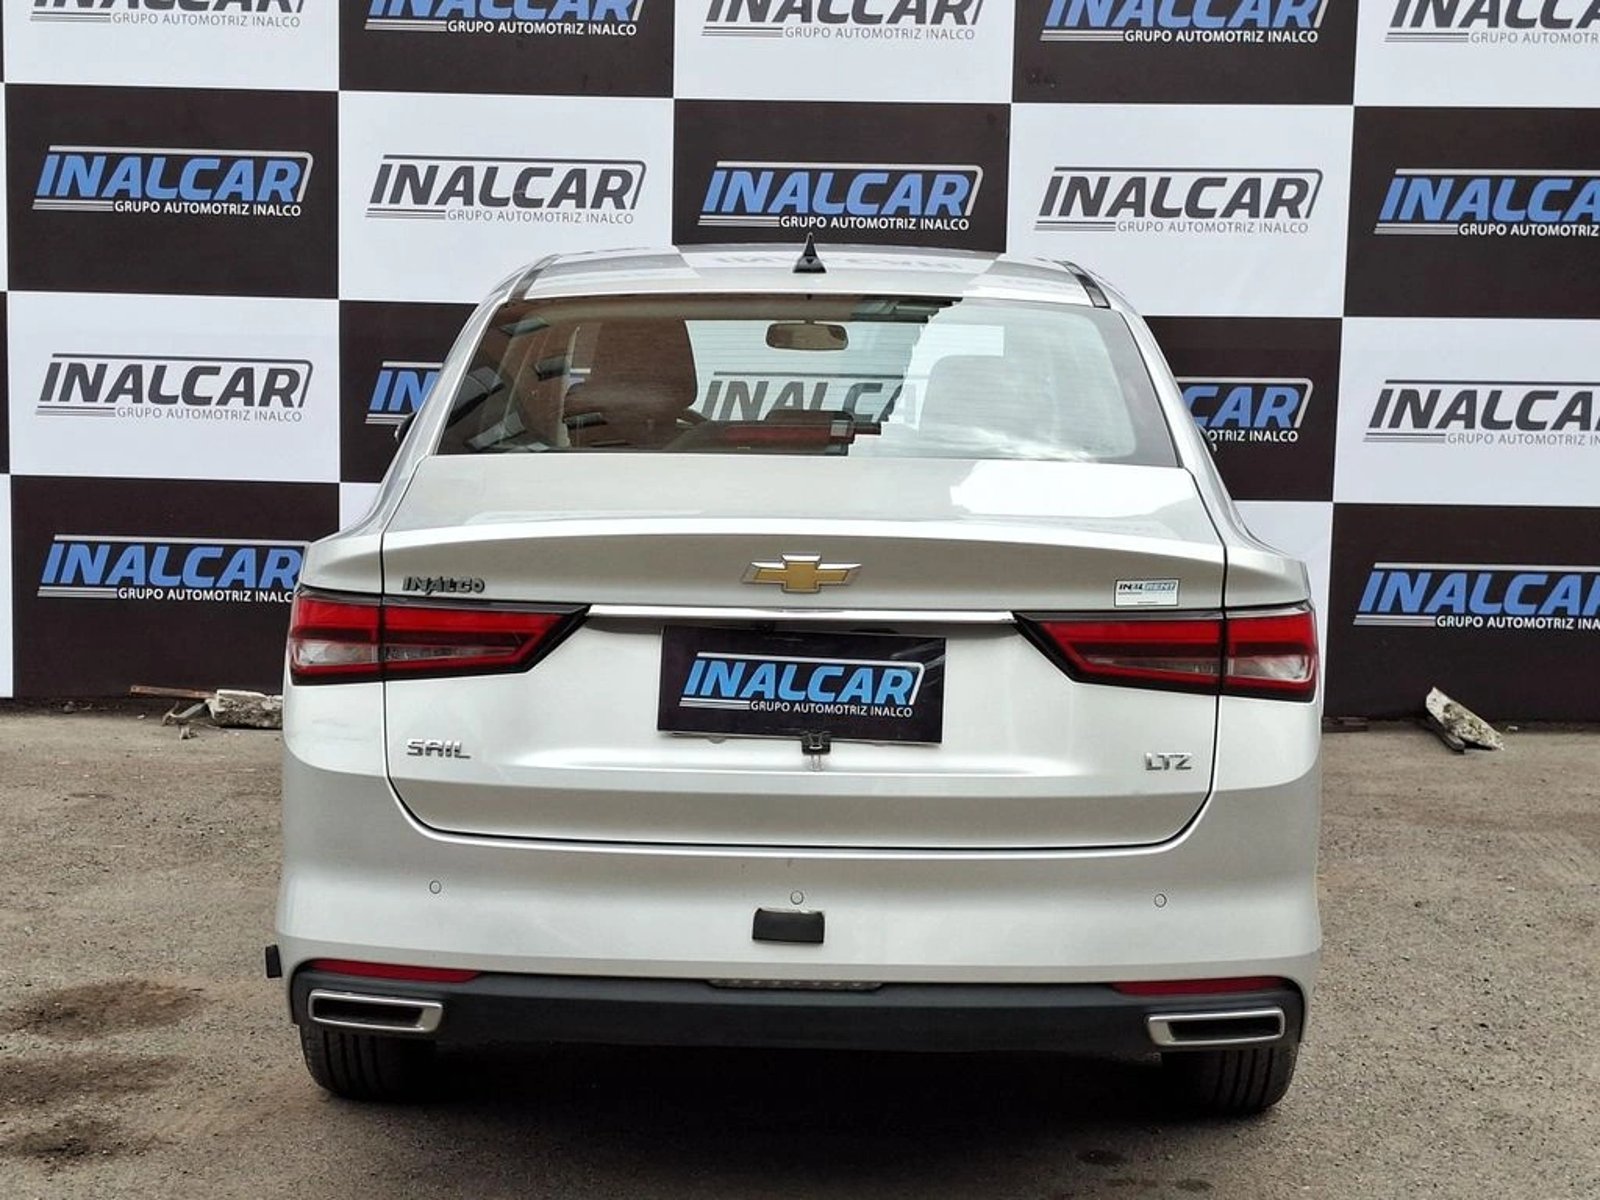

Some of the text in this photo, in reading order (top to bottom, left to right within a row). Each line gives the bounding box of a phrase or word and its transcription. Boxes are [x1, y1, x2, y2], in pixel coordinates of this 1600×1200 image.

[111, 11, 301, 28] GRUPO AUTOMOTRIZ INALCO
[1045, 0, 1313, 28] INALCAR
[447, 19, 637, 36] GRUPO AUTOMOTRIZ INALCO
[784, 25, 975, 41] GRUPO AUTOMOTRIZ INALCO
[1124, 29, 1319, 43] GRUPO AUTOMOTRIZ INALCO
[1470, 31, 1519, 44] GRUPO
[36, 155, 302, 203] INALCAR
[369, 163, 635, 210] INALCAR
[703, 170, 970, 217] INALCAR
[1039, 176, 1309, 219] INALCAR
[114, 200, 302, 217] GRUPO AUTOMOTRIZ INALCO
[447, 208, 634, 225] GRUPO AUTOMOTRIZ INALCO
[778, 215, 970, 231] GRUPO AUTOMOTRIZ INALCO
[1116, 220, 1309, 234] GRUPO AUTOMOTRIZ INALCO
[1458, 223, 1600, 237] GRUPO AUTOMOTRIZ
[39, 361, 302, 408] INALCAR
[114, 406, 303, 423] GRUPO AUTOMOTRIZ INALCO
[1369, 388, 1600, 431] INALCA
[1249, 430, 1299, 442] INALCO
[1445, 432, 1495, 445] GRUPO
[1497, 433, 1587, 447] AUTOMOTRIZ
[41, 543, 303, 590] INALCAR
[115, 587, 164, 600] GRUPO
[166, 588, 252, 602] AUTOMOTRIZ
[1434, 615, 1484, 628] GRUPO
[1486, 616, 1575, 630] AUTOMOTRIZ
[683, 660, 914, 705] INALCAR
[751, 701, 912, 718] GRUPO AUTOMOTRIZ INALCO
[407, 738, 471, 759] SAIL
[1144, 752, 1192, 771] LTZ
